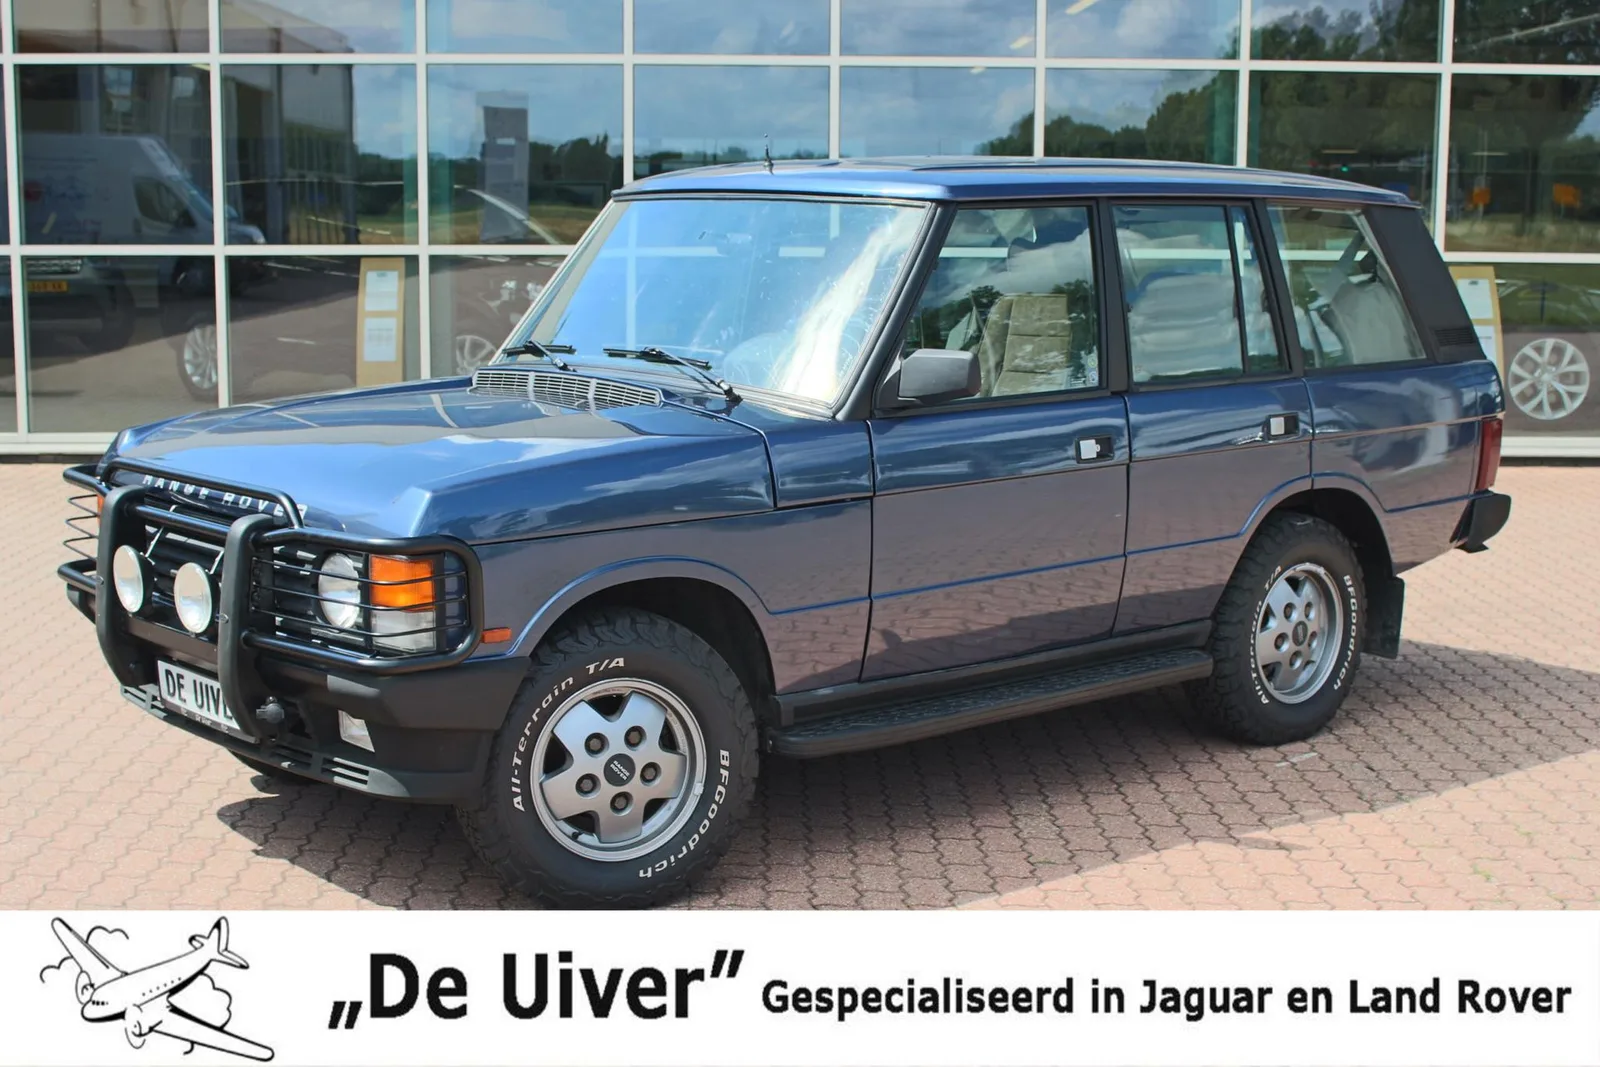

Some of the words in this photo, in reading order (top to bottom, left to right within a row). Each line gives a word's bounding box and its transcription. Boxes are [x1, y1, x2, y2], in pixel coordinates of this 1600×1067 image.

[142, 474, 209, 500] RANGE
[1333, 574, 1358, 690] BFGoodrich
[164, 668, 187, 703] DE
[510, 676, 574, 812] All-Terrain
[585, 657, 625, 676] T/A
[610, 763, 627, 780] ROVER
[613, 760, 630, 777] RANGE
[638, 749, 731, 880] BFGoodrich
